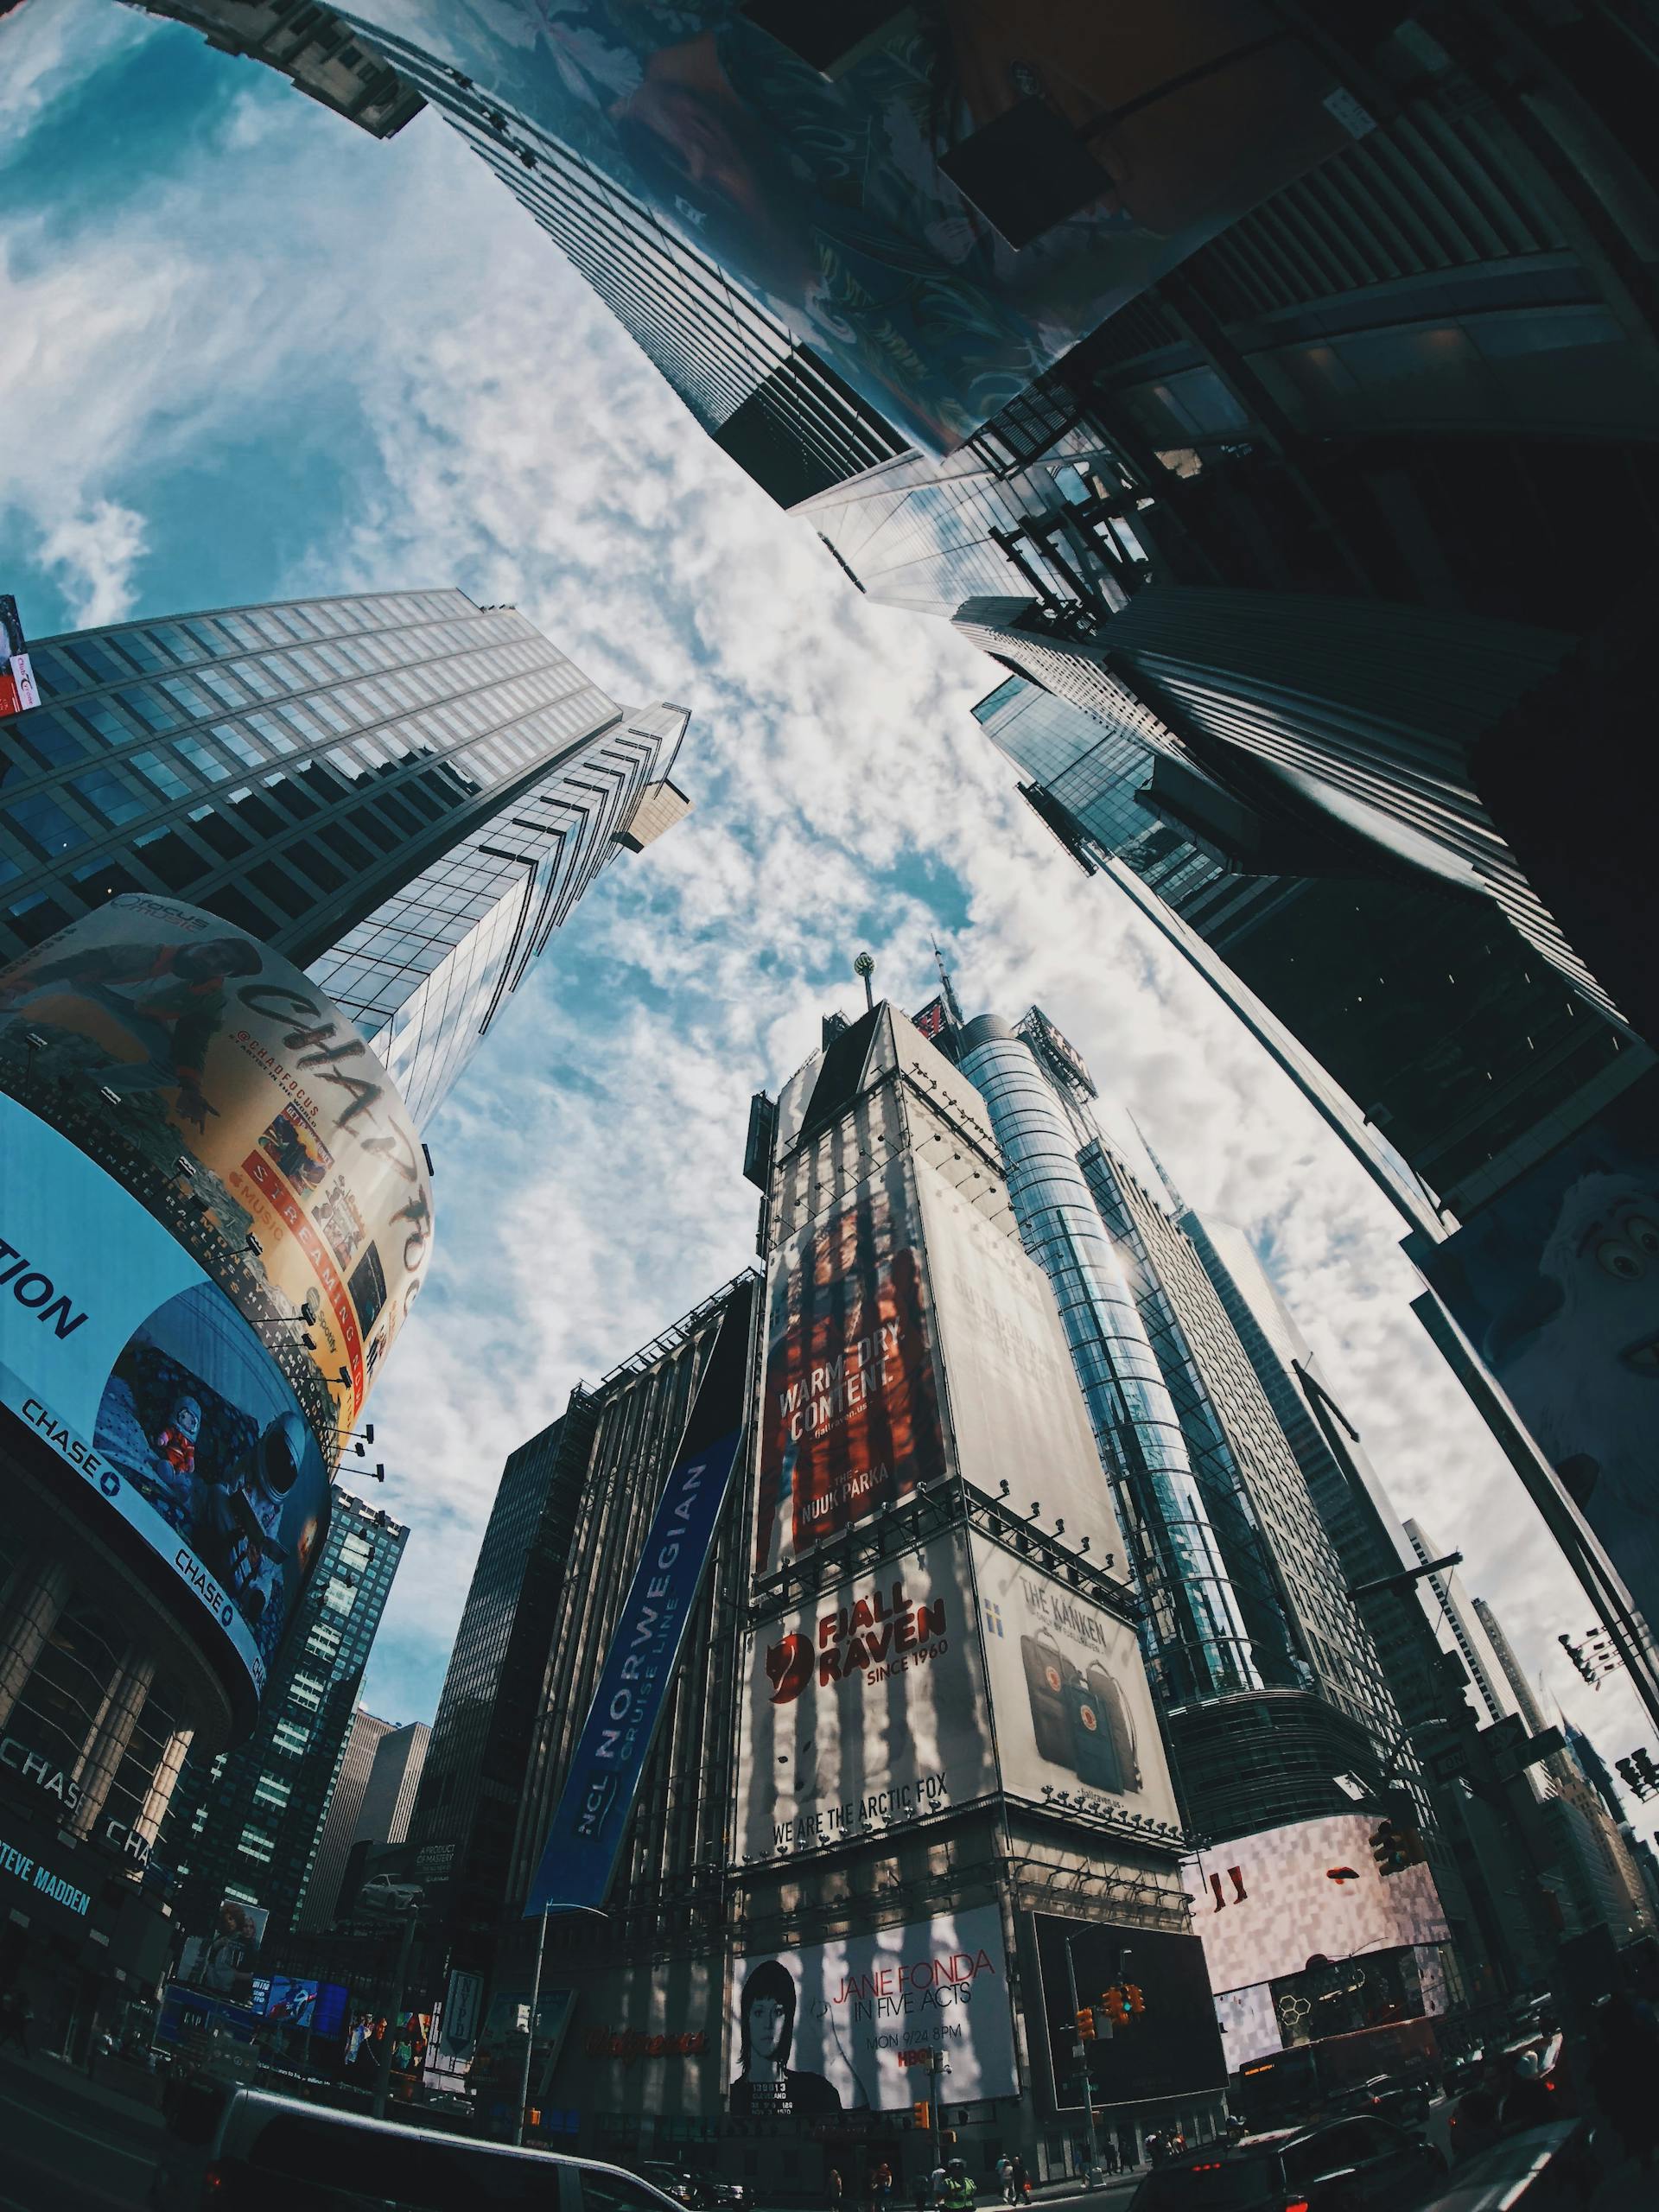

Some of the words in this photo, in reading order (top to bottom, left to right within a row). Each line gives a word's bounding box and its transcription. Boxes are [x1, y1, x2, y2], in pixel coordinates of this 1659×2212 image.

[138, 895, 210, 931] focus
[237, 1030, 319, 1117] @CHADFOCUS
[269, 1071, 277, 1081] IN
[278, 1083, 292, 1098] THE
[293, 1098, 317, 1128] WORLD
[240, 1185, 284, 1241] MUSIC
[253, 1166, 356, 1341] STREAMING
[318, 1309, 337, 1354] Spotify
[779, 1351, 851, 1419] WARM.
[856, 1316, 906, 1369] DRY.
[790, 1354, 893, 1441] CONTENT.
[22, 1399, 102, 1479] CHASE
[801, 1490, 841, 1525] NUUK
[842, 1462, 889, 1503] PARKA
[833, 1470, 853, 1484] THE
[175, 1548, 225, 1614] CHASE
[595, 1463, 707, 1759] NORWEGIAN
[1020, 1575, 1050, 1615] THE
[819, 1598, 947, 1688] RÄVEN
[868, 1660, 909, 1686] SINCE
[912, 1639, 949, 1666] 1960
[620, 1664, 658, 1761] CRUISE
[657, 1596, 679, 1654] LINE
[577, 1774, 609, 1836] NCL
[773, 1821, 792, 1846] WE
[797, 1813, 823, 1840] ARE
[828, 1803, 854, 1830] THE
[859, 1786, 911, 1821] ARCTIC
[916, 1772, 948, 1802] FOX
[427, 1844, 456, 1854] PRODUCT
[33, 1866, 91, 1916] MADDEN
[455, 1976, 474, 2037] NYPD
[834, 1969, 893, 2004] JANE
[898, 1949, 995, 1993] FONDA
[855, 2000, 873, 2022] IN
[878, 1992, 914, 2018] FIVE
[920, 1981, 972, 2012] ACTS
[867, 2034, 899, 2050] MON
[902, 2033, 929, 2046] 9/24
[931, 2024, 963, 2041] 8PM
